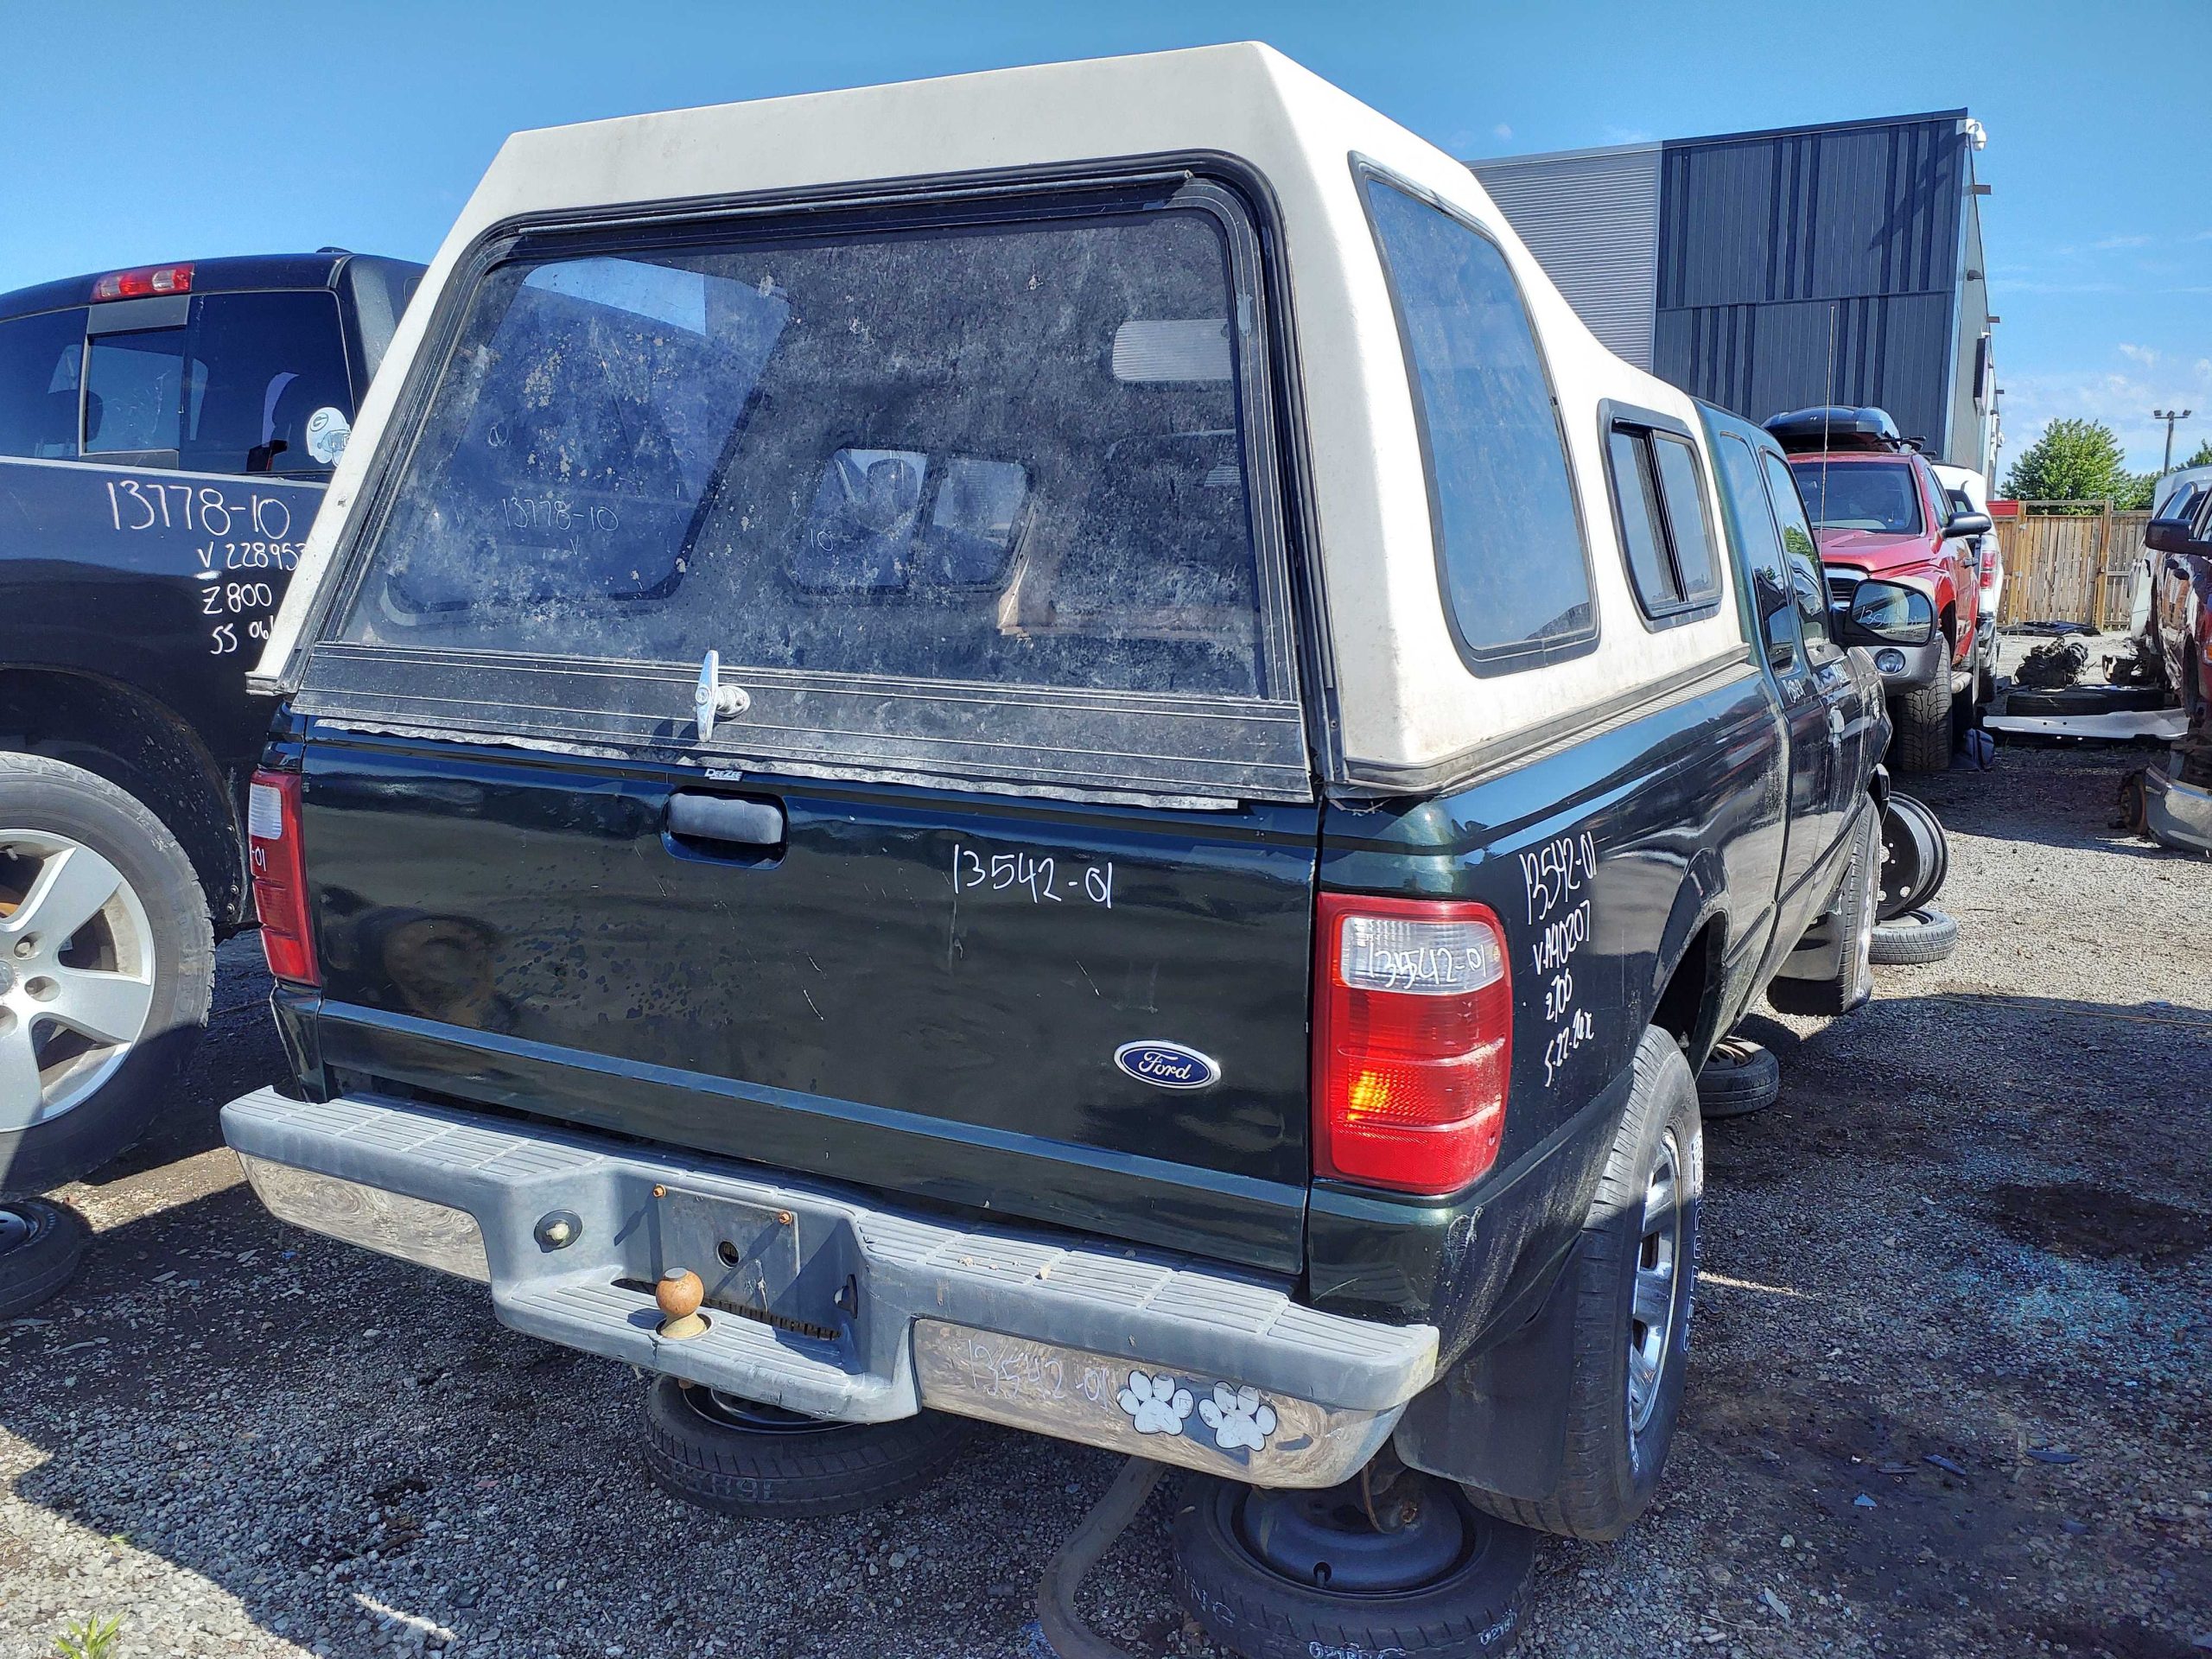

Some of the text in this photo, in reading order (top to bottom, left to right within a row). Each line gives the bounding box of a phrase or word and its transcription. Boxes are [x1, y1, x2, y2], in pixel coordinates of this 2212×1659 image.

[106, 480, 290, 539] 13778-10
[502, 497, 619, 531] 13778-10
[197, 541, 214, 569] V
[953, 843, 1112, 909] 13542-01
[1138, 1050, 1192, 1080] Ford
